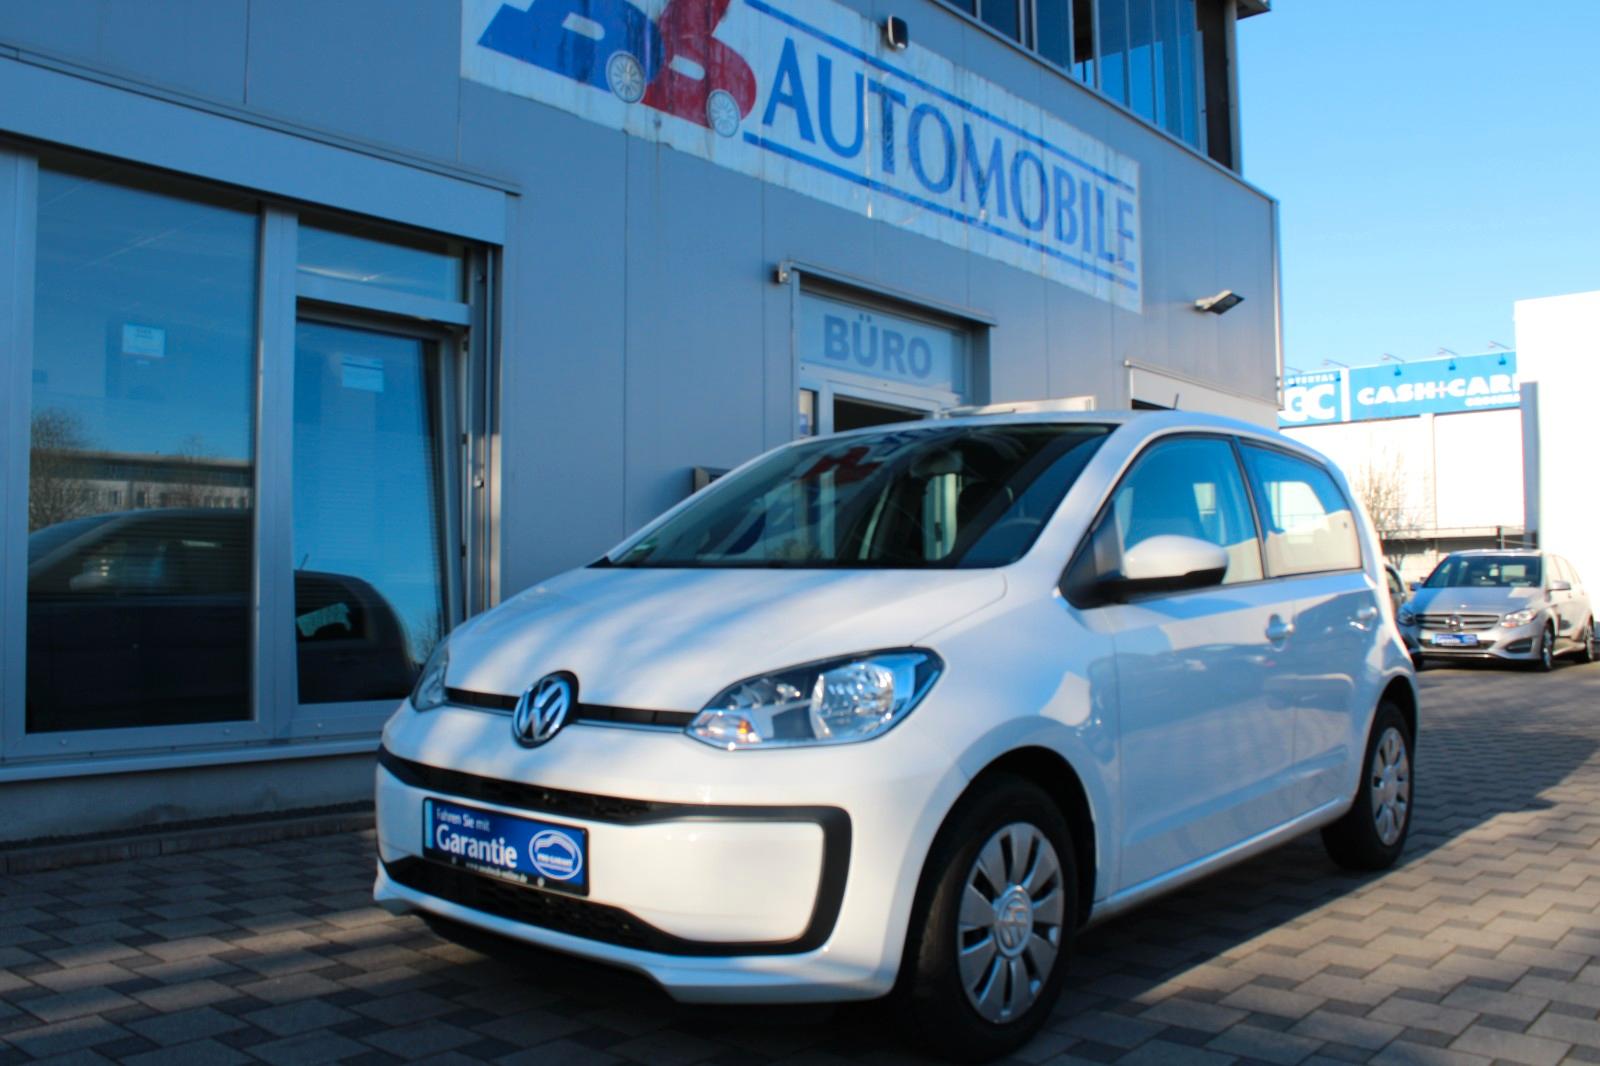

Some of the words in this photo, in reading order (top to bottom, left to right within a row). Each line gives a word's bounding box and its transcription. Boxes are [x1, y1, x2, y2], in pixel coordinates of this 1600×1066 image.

[762, 38, 1135, 272] AUTOMOBILE
[823, 313, 932, 379] BÜRO
[436, 823, 518, 869] Garantie
